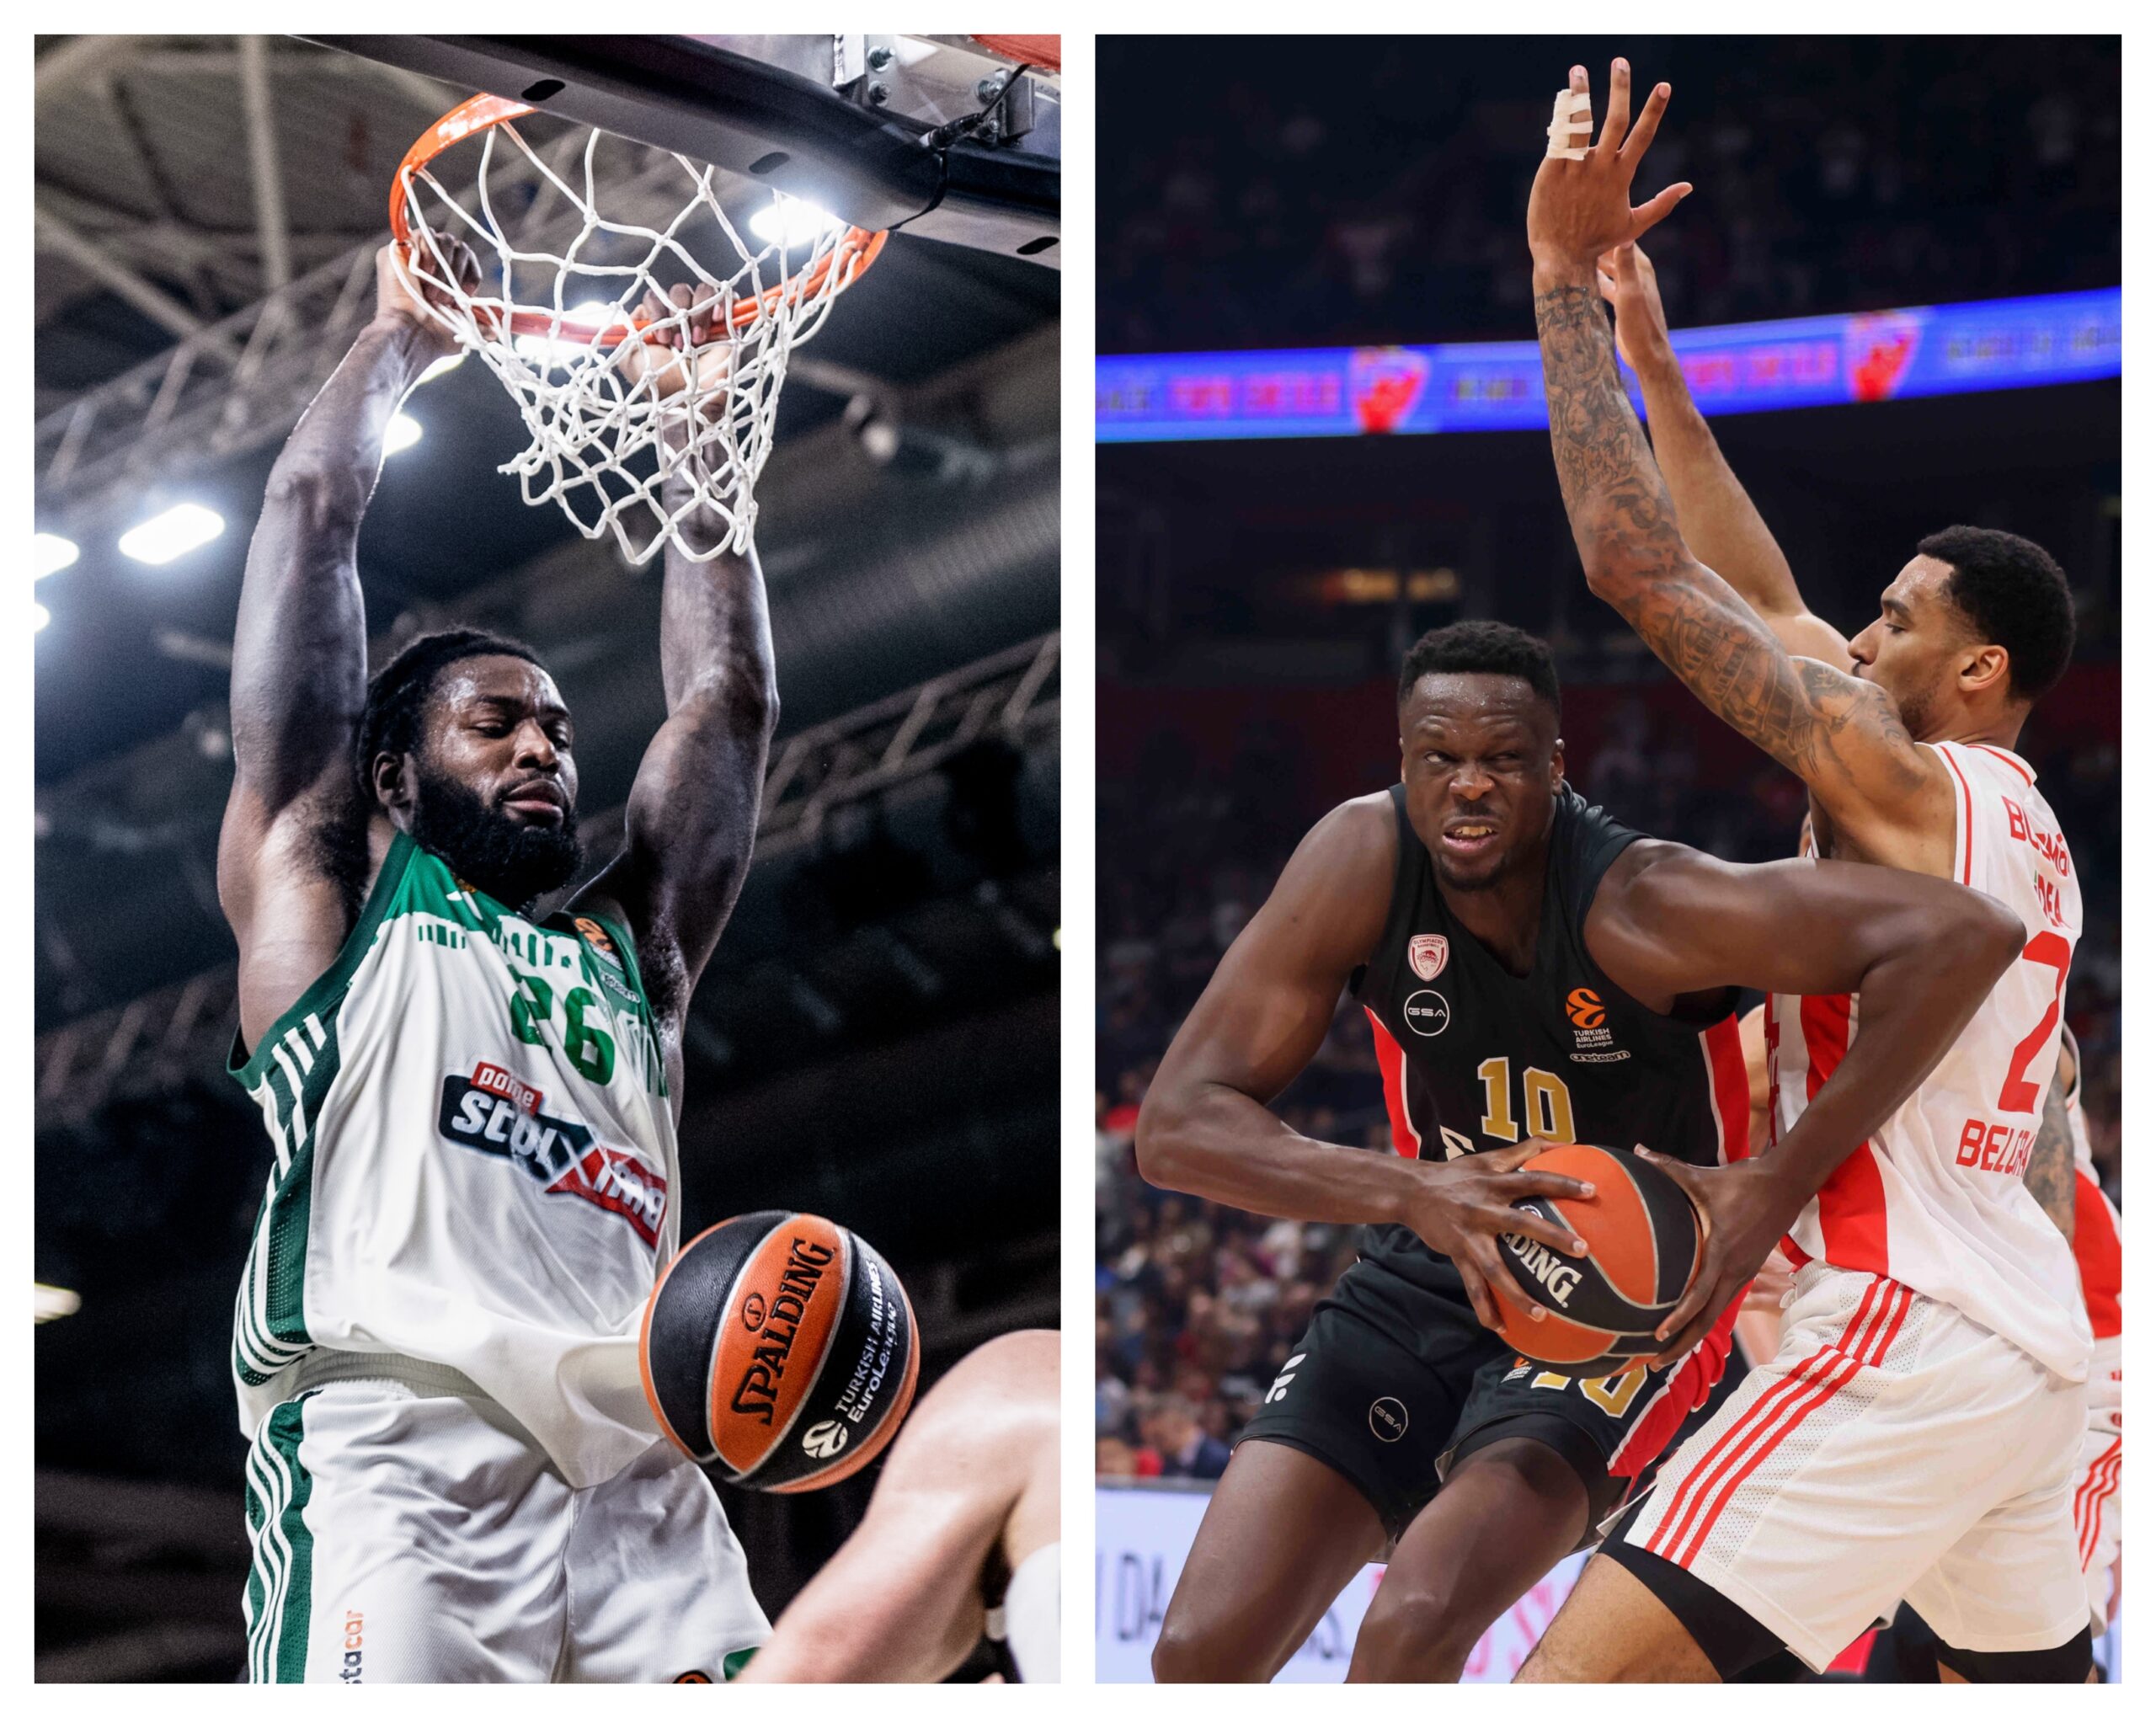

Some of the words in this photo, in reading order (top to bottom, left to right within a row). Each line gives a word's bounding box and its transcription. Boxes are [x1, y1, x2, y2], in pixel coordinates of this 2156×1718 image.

[507, 963, 616, 1086] 26
[1407, 1007, 1446, 1017] GSA
[1573, 1027, 1609, 1037] TURKISH
[1576, 1034, 1612, 1043] AIRLINES
[1577, 1040, 1614, 1048] EuroLeague
[1998, 931, 2071, 1114] 2
[1477, 1056, 1577, 1145] 10
[731, 1237, 835, 1427] SPALDING
[835, 1337, 880, 1413] TURKISH
[866, 1260, 883, 1337] AIRLINES
[847, 1301, 899, 1424] EuroLeague
[1374, 1406, 1401, 1433] GSA
